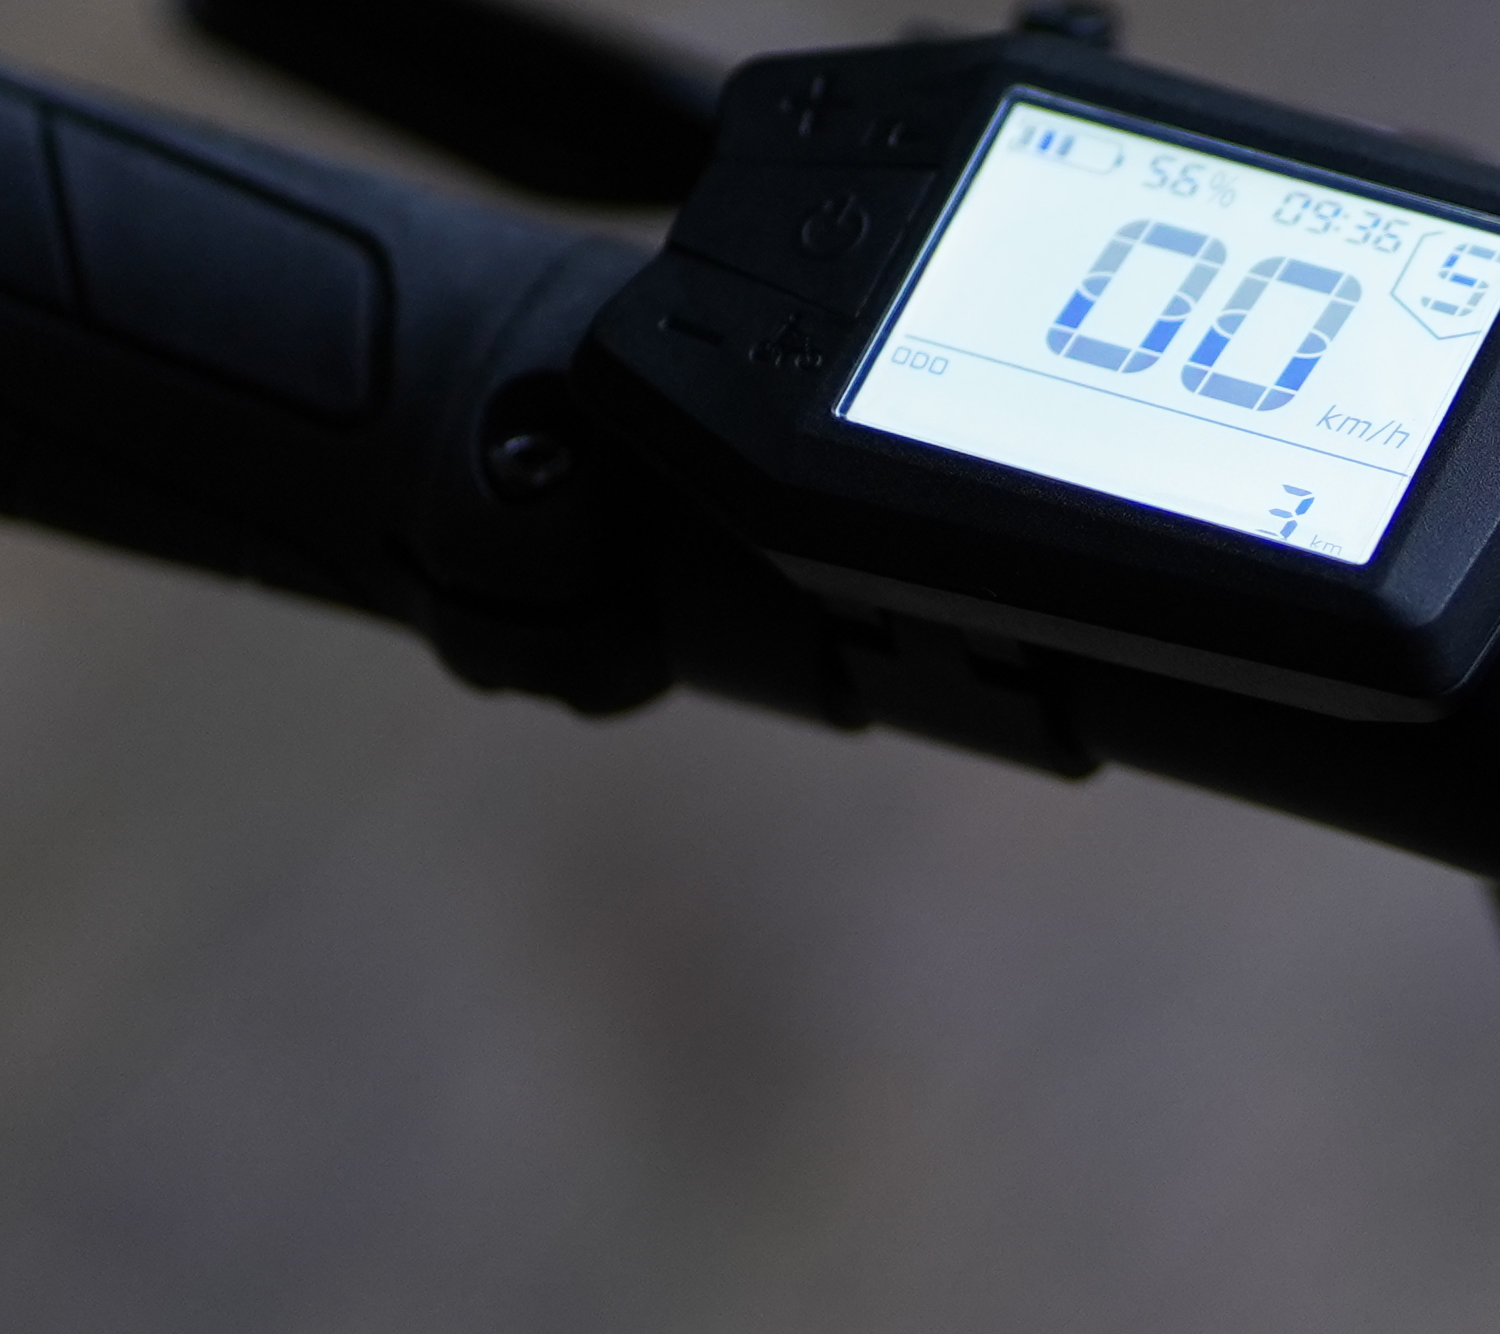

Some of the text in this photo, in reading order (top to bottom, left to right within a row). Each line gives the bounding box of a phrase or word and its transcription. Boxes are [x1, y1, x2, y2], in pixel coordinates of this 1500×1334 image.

[1272, 189, 1411, 254] 09:36
[1045, 218, 1363, 412] 00
[1315, 404, 1411, 449] km/h
[1255, 483, 1343, 556] 3 km
